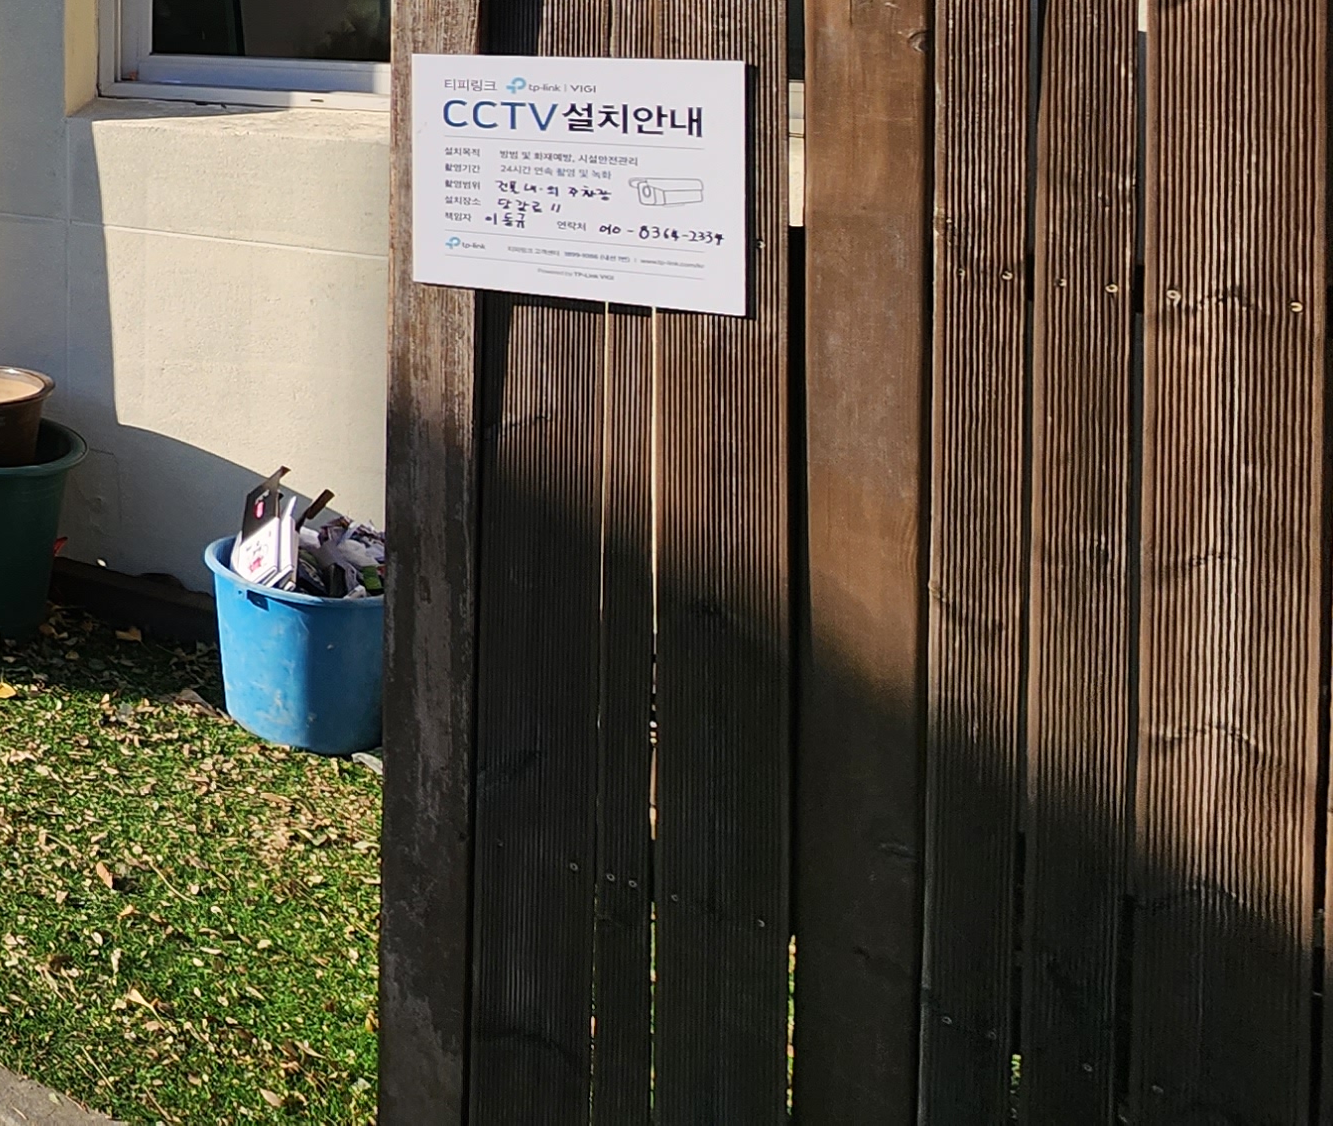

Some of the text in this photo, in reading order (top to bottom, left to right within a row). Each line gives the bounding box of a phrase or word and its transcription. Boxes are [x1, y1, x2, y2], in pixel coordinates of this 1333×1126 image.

[444, 78, 497, 92] 티피링크
[570, 84, 597, 93] VIGI
[445, 147, 480, 157] 설치목적
[500, 150, 519, 160] 방범
[521, 151, 531, 160] 및
[578, 153, 638, 166] 시설안전관리
[445, 163, 612, 180] 촬영기간 24시간 연속 촬영 및 녹화
[445, 179, 481, 190] 촬영범위
[445, 195, 481, 206] 설치장소
[445, 212, 471, 222] 책임자
[557, 221, 586, 231] 연락처
